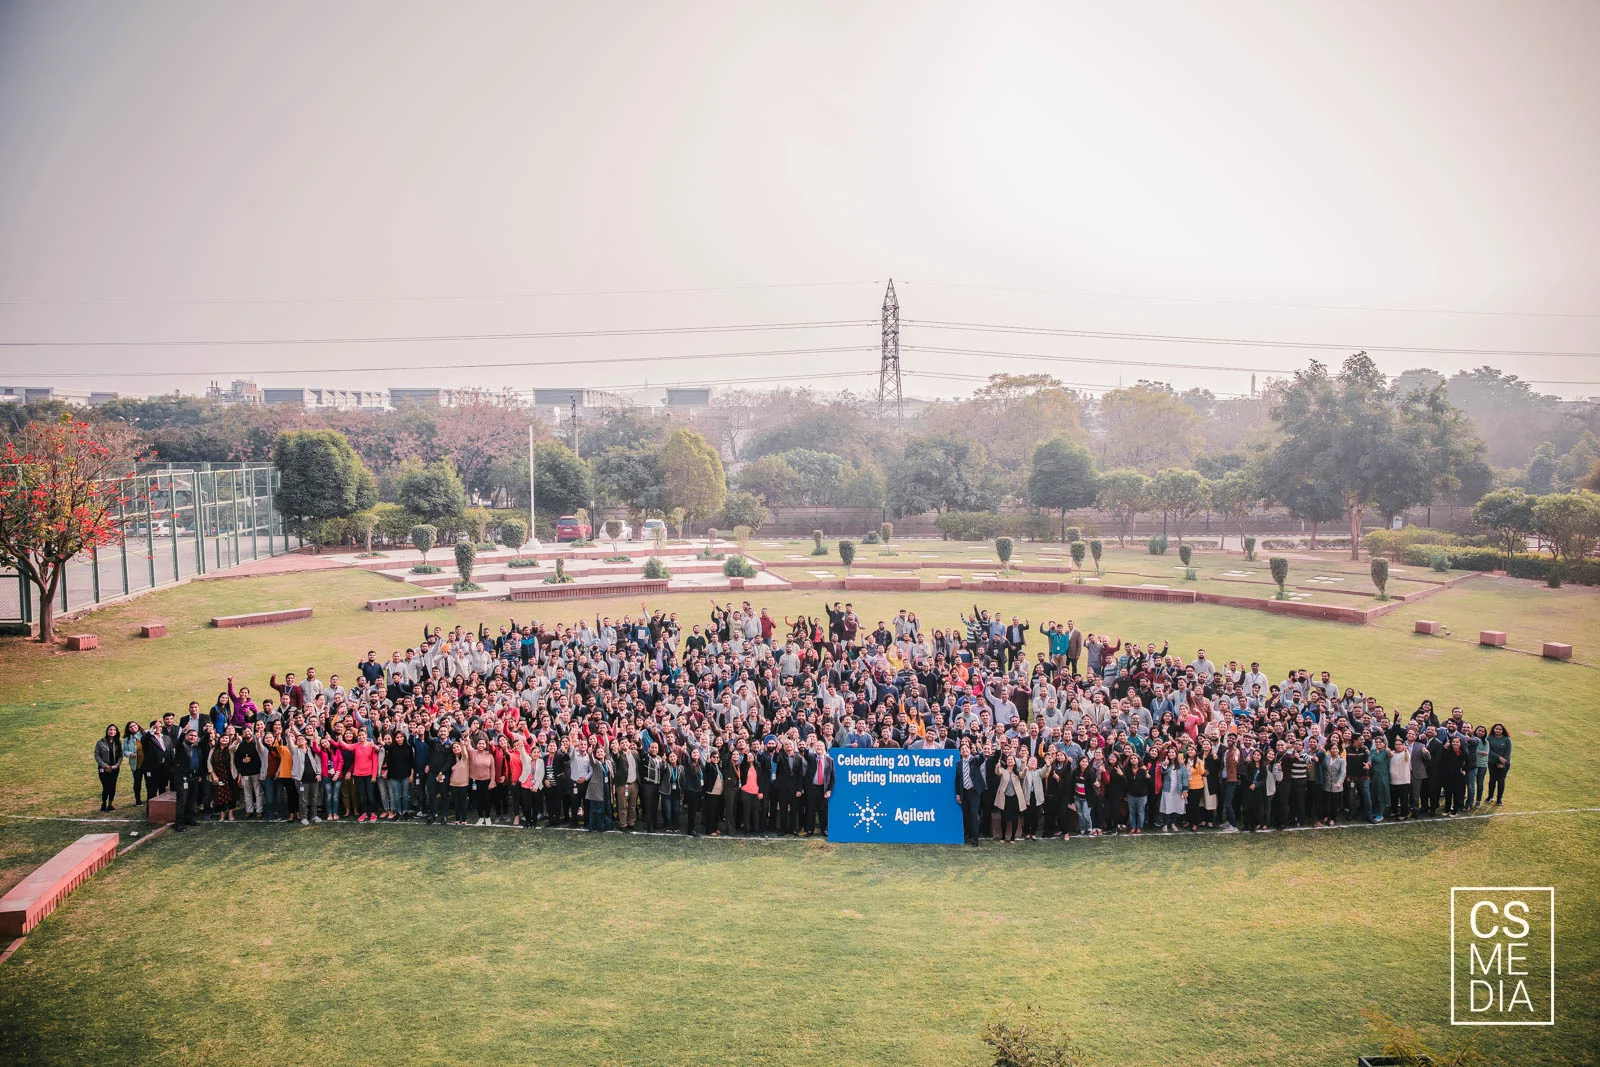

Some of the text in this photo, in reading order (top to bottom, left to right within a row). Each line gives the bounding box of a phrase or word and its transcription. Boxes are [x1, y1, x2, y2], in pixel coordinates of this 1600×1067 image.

[837, 754, 954, 769] Celebrating 20 Years of
[848, 770, 941, 786] Igniting Innovation
[894, 808, 936, 825] Agilent
